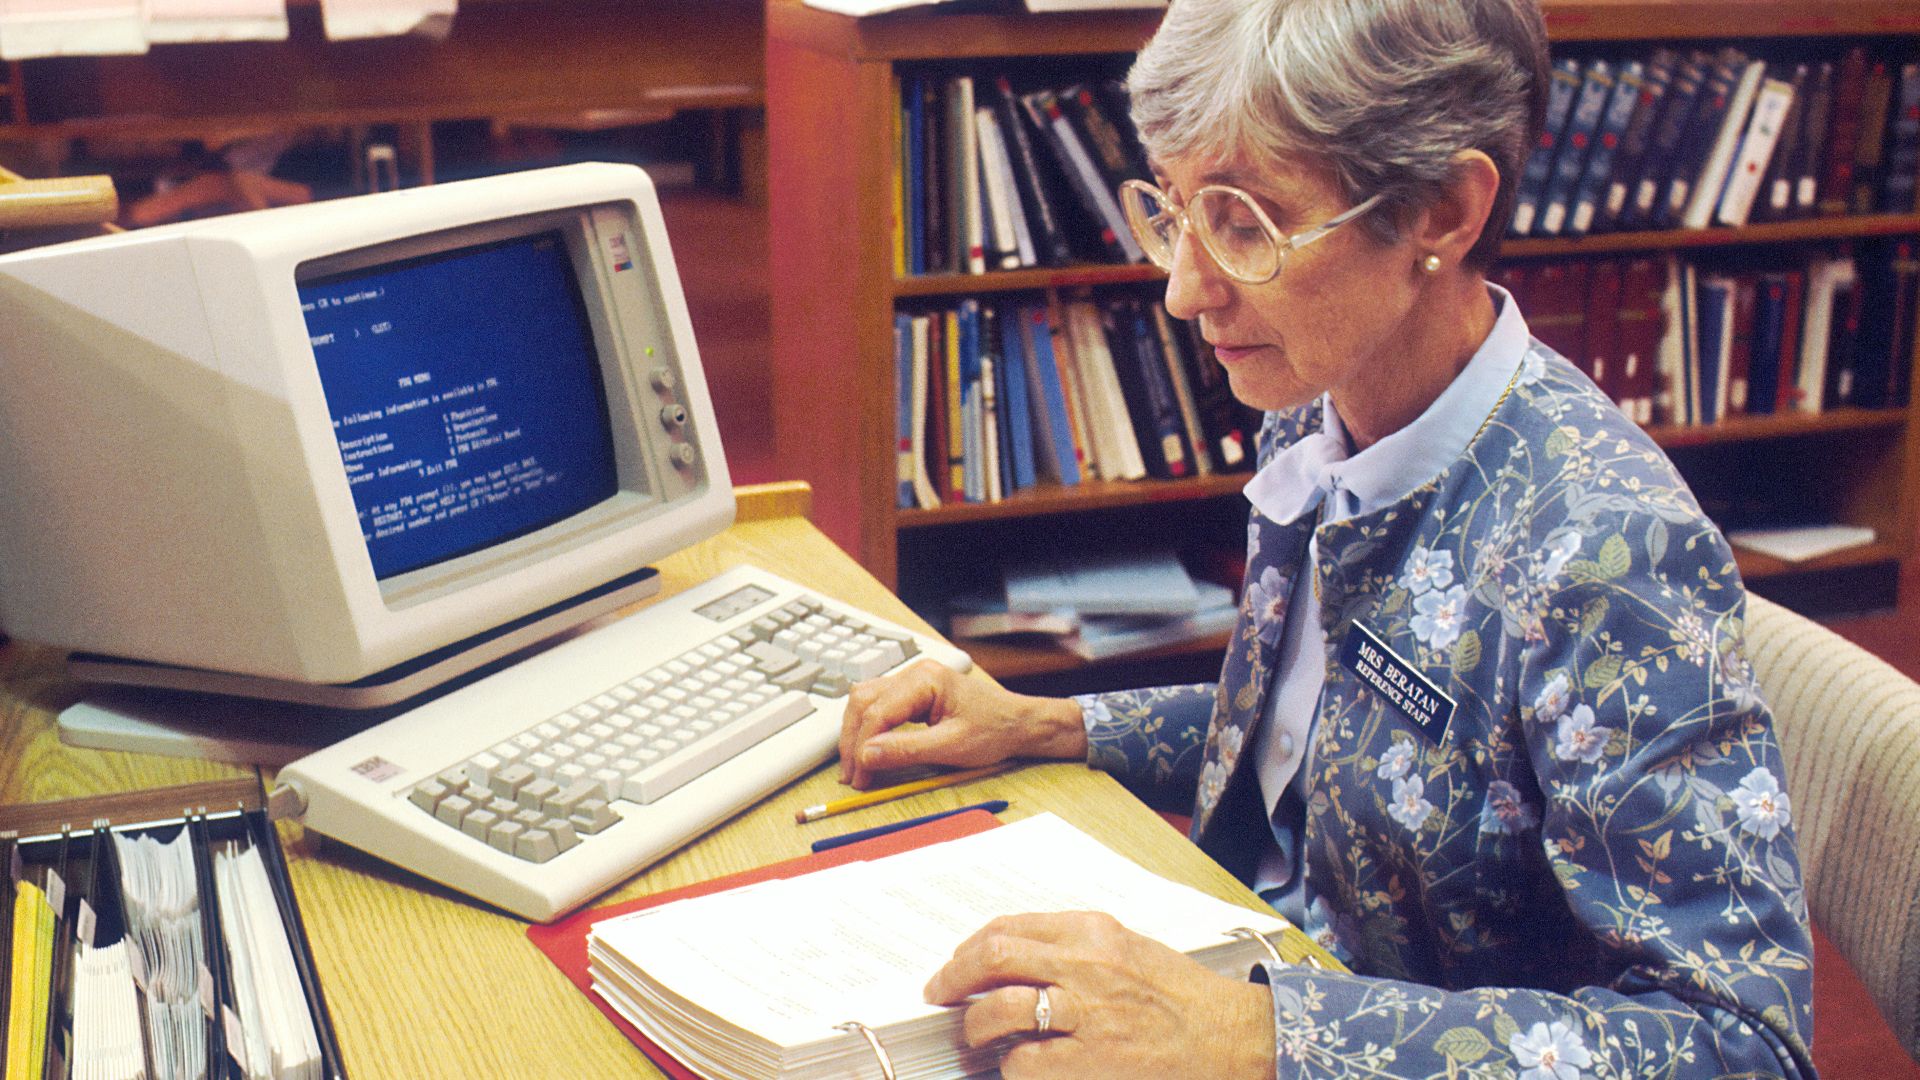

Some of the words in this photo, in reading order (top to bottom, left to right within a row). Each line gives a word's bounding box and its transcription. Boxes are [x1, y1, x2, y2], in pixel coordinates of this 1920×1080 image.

[343, 410, 382, 426] following
[385, 398, 429, 416] information
[432, 394, 440, 404] is
[442, 385, 475, 401] available
[340, 432, 388, 451] Description
[343, 442, 394, 462] Instructions
[415, 487, 440, 505] prompt
[375, 520, 405, 539] desired
[1355, 659, 1404, 705] REFERENCE
[1402, 699, 1431, 726] STAFF
[1384, 663, 1440, 715] BERATAN
